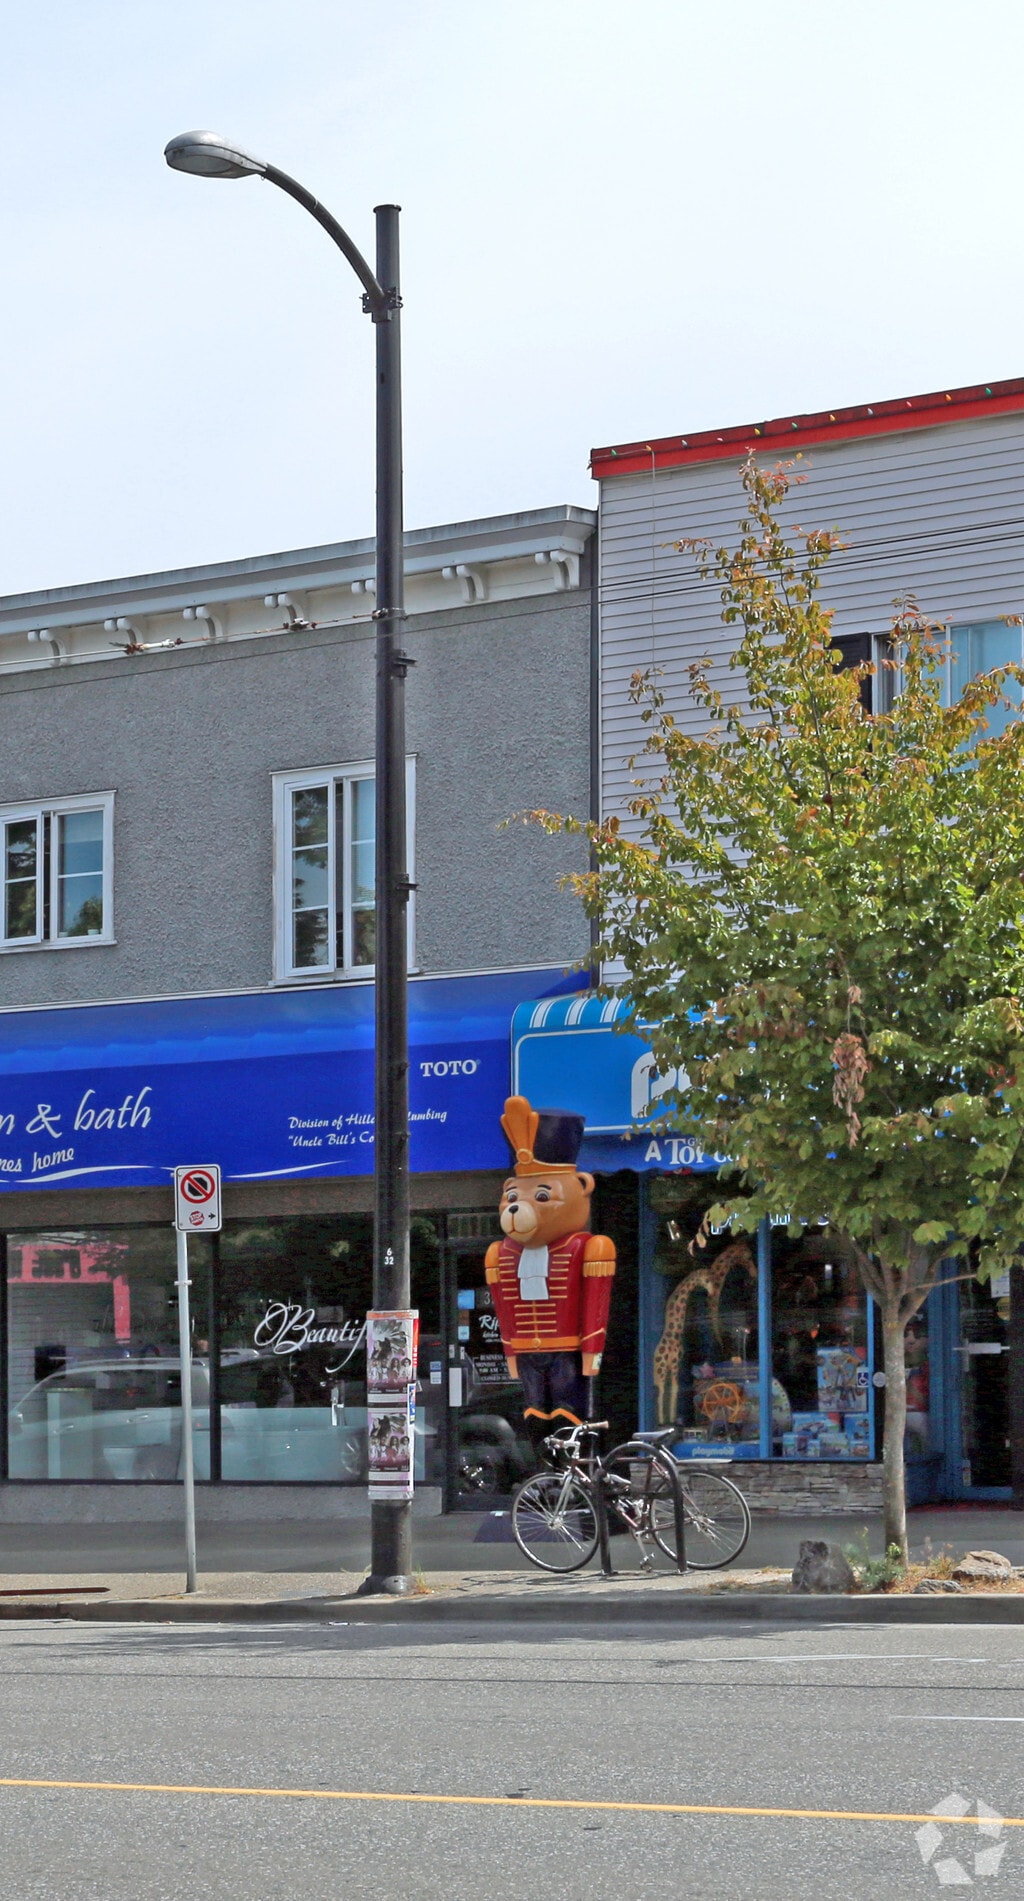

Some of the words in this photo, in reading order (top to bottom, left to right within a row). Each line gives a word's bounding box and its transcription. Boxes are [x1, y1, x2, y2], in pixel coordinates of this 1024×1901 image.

[420, 1059, 477, 1077] TOTO
[26, 1103, 63, 1139] &
[74, 1086, 152, 1131] bath
[288, 1116, 329, 1129] Division
[332, 1114, 343, 1130] of
[408, 1109, 448, 1122] lumbing
[326, 1132, 356, 1146] Bill's
[31, 1147, 75, 1173] home
[644, 1140, 662, 1162] A
[384, 1256, 395, 1265] 32
[386, 1247, 393, 1256] 6
